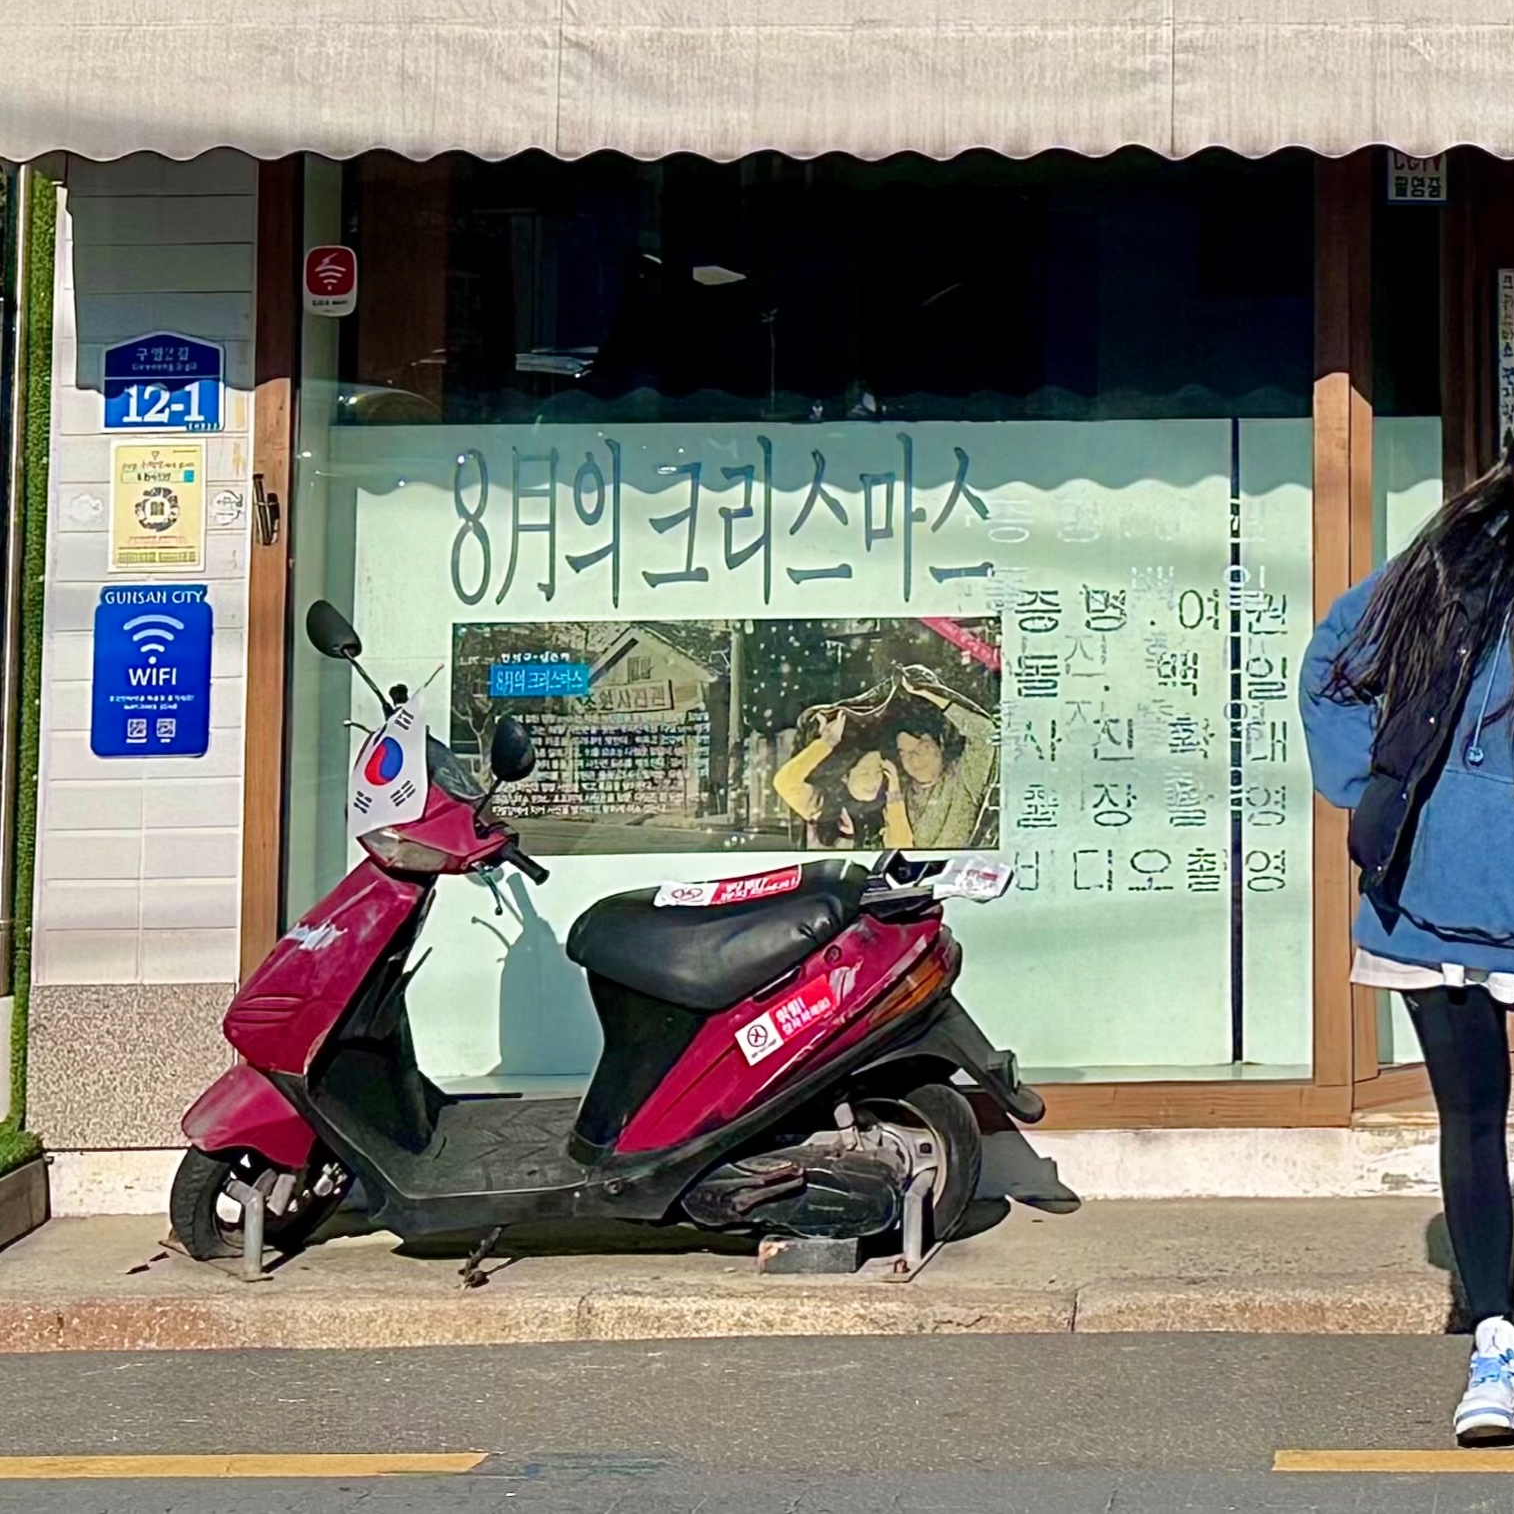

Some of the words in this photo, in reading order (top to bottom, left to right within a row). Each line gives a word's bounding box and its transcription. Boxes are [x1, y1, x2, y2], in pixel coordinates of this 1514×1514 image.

[122, 381, 205, 423] 12-1
[642, 432, 996, 606] 크리스마스
[104, 591, 167, 605] GUNSAN
[171, 590, 205, 604] CITY
[128, 667, 177, 686] WIFI
